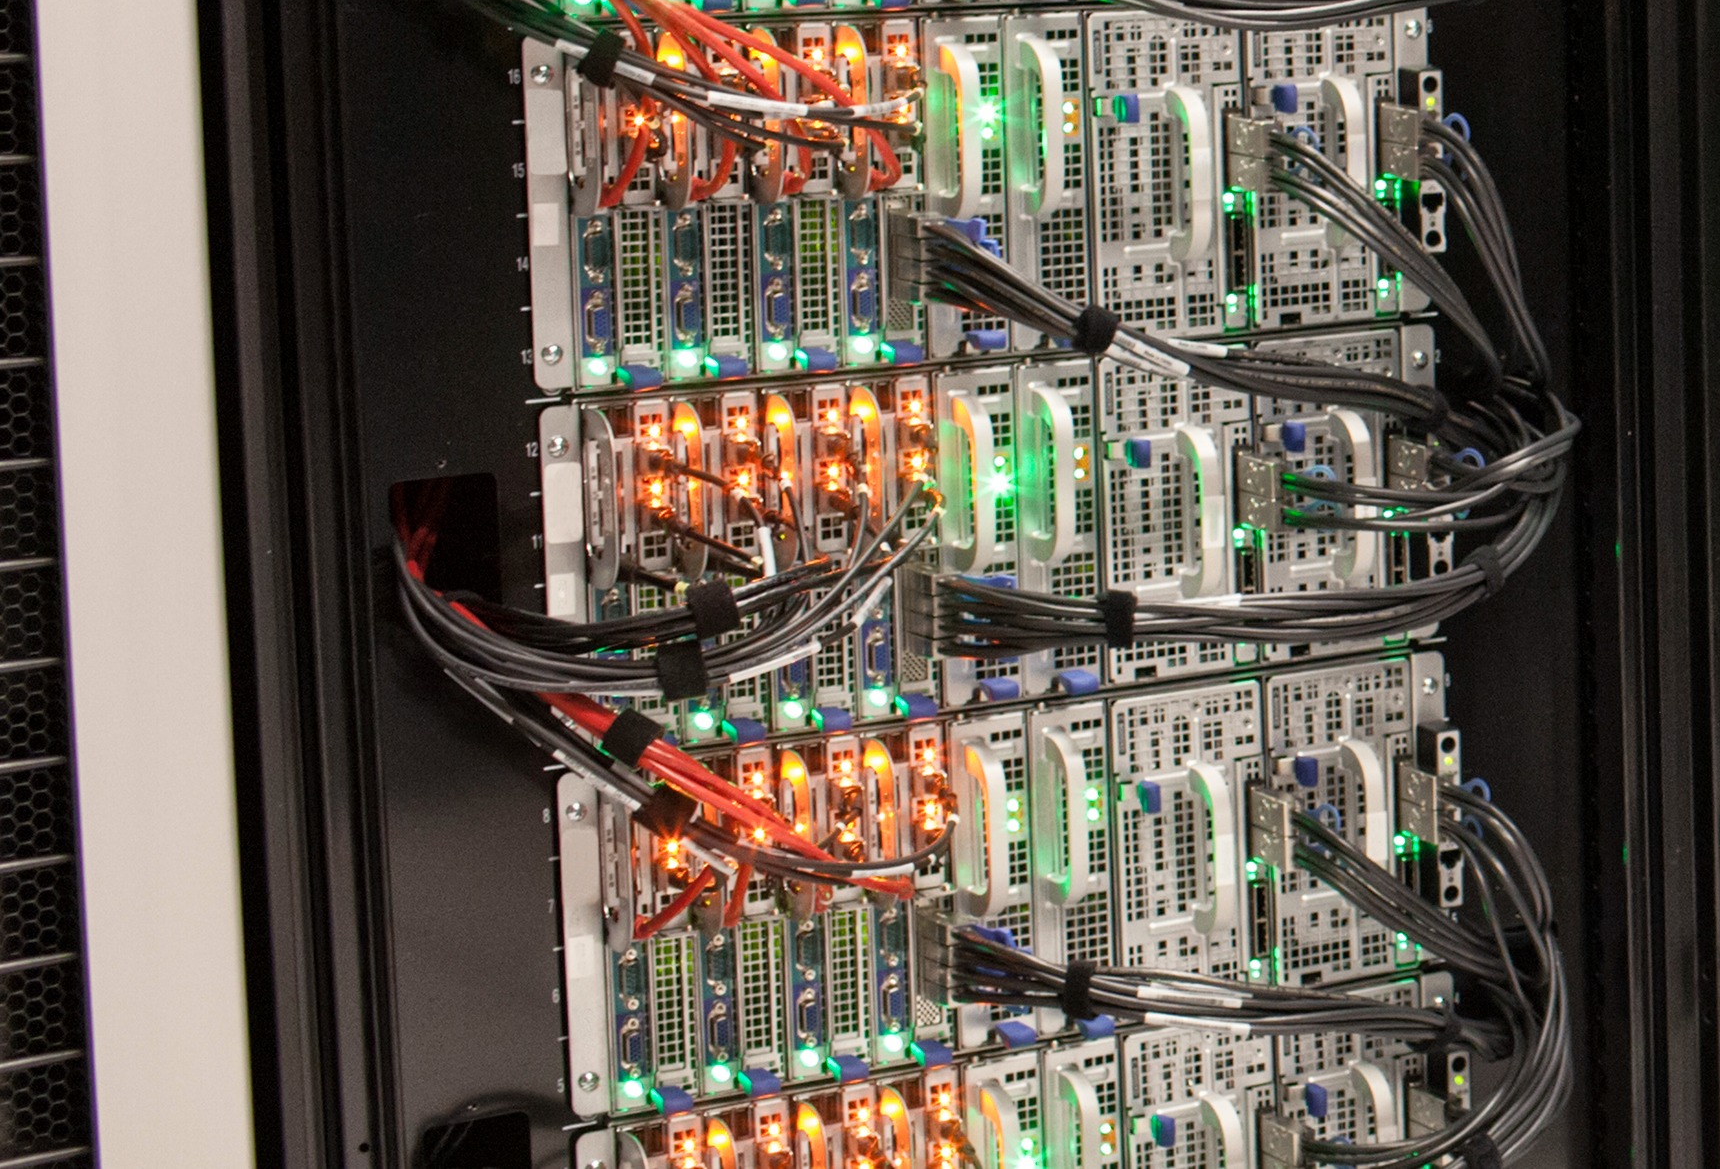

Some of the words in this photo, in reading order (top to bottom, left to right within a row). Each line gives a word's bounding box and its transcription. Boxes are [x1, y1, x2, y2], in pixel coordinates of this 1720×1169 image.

[508, 70, 521, 84] 16
[512, 164, 525, 178] 15
[516, 257, 529, 271] 14
[521, 349, 533, 365] 13
[1435, 348, 1441, 363] 2
[525, 442, 539, 457] 12
[531, 535, 543, 549] 11
[542, 808, 551, 823] 8
[547, 899, 556, 913] 7
[552, 989, 561, 1004] 6
[557, 1079, 566, 1094] 5
